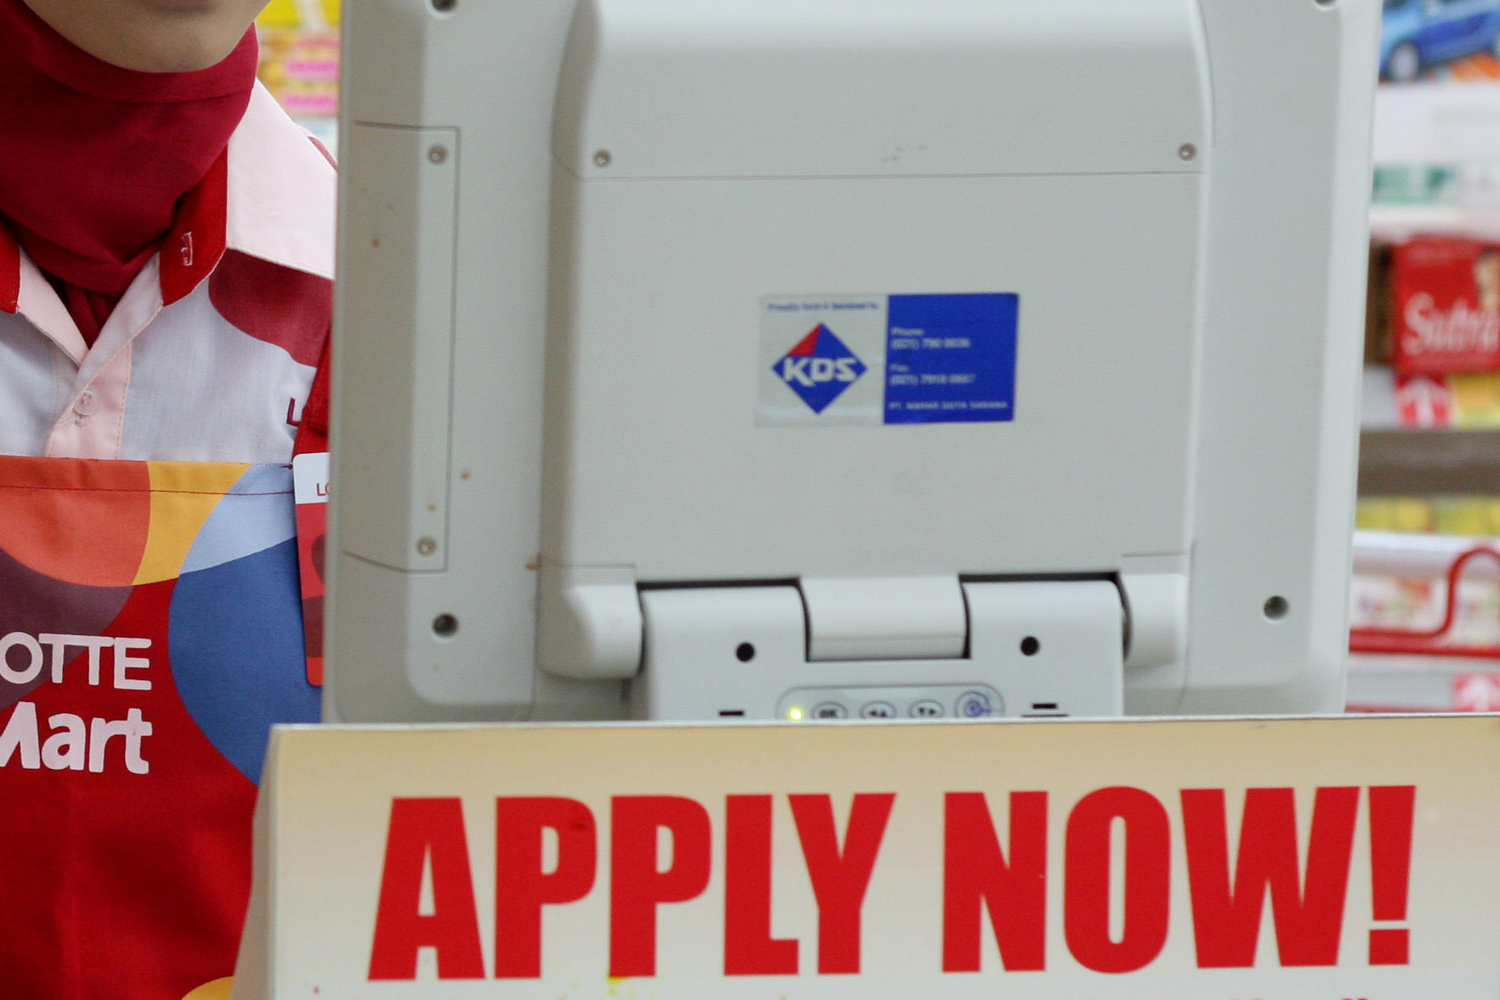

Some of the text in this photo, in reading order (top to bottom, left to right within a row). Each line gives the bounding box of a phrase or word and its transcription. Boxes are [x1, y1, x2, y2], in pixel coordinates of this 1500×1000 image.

[782, 357, 857, 387] KDS
[368, 785, 1416, 980] APPLY NOW!
